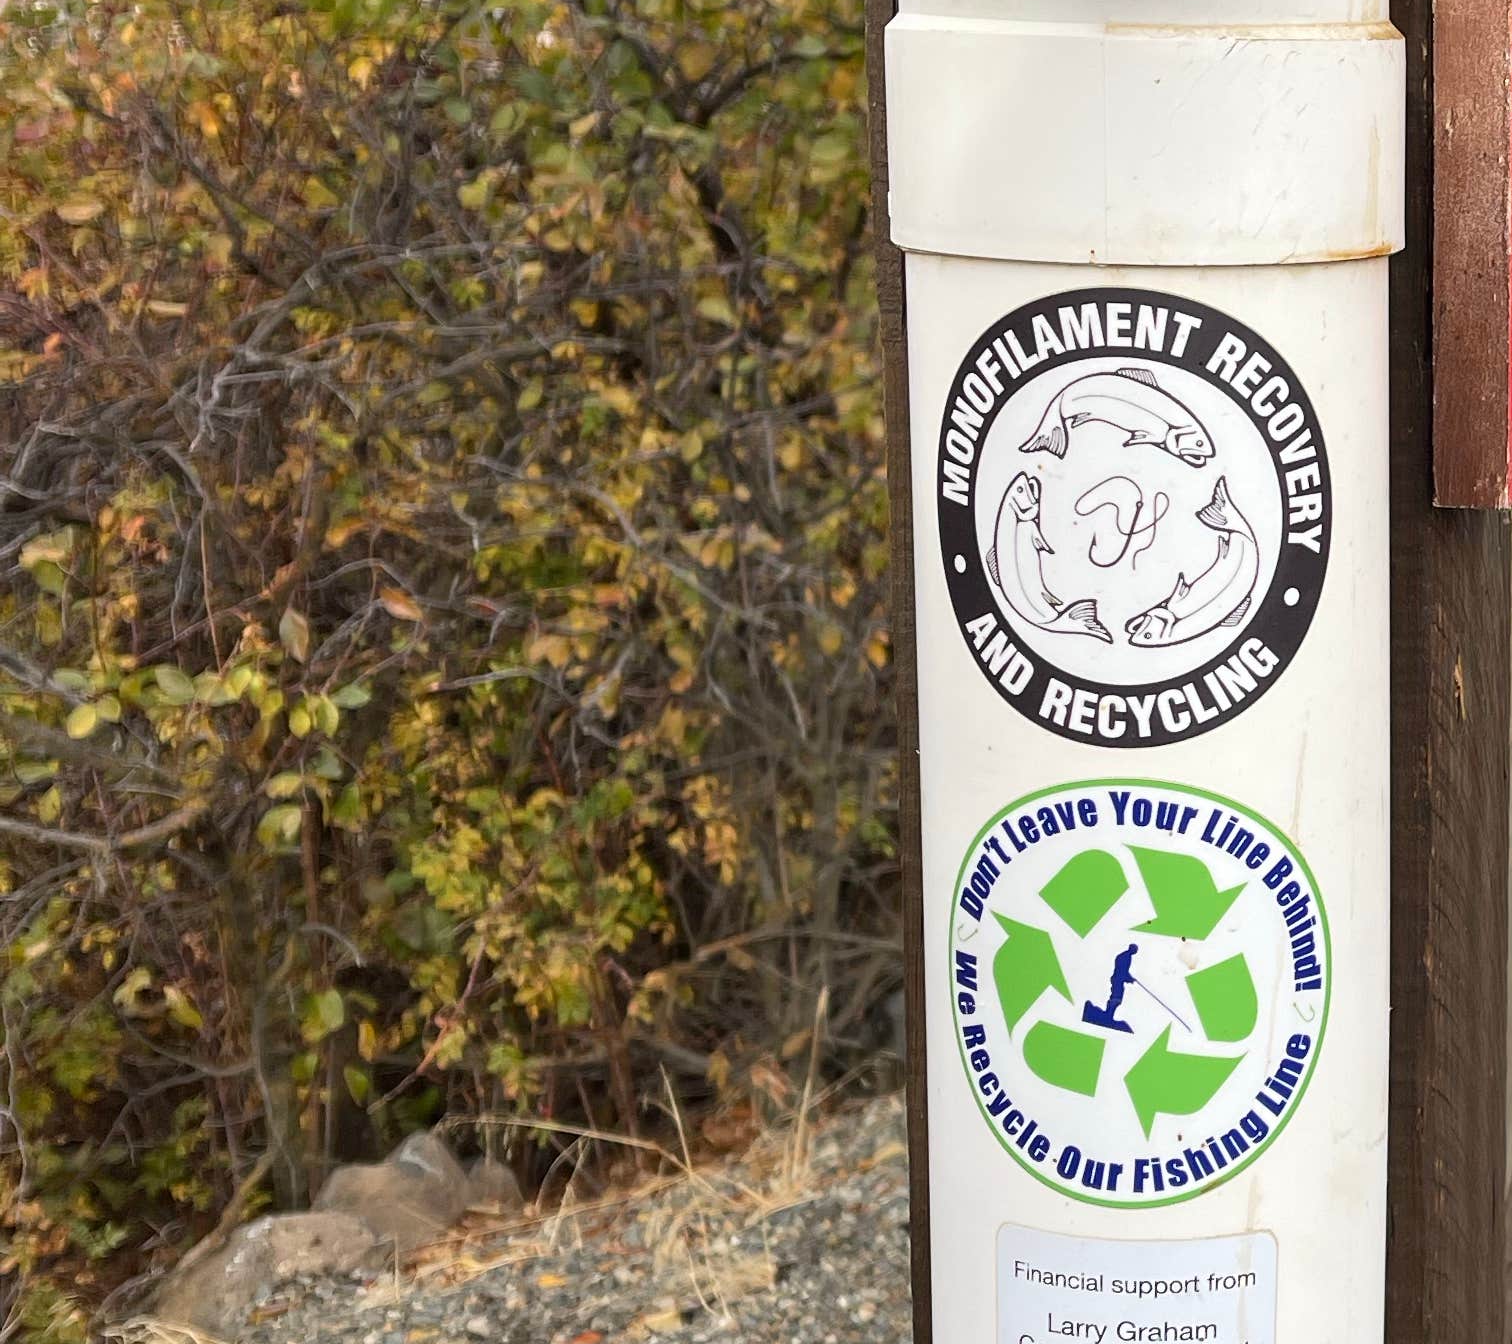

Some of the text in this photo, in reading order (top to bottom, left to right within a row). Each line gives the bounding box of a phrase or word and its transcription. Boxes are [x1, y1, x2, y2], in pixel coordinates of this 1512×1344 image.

[942, 302, 1324, 554] MONOFILAMENT RECOVERY
[965, 612, 1280, 739] AND RECYCLING
[959, 791, 1322, 992] Don't Leave Your Line Behind!
[955, 949, 1311, 1194] We Recycle Our Fishing Line
[1014, 1260, 1257, 1299] Financial support from
[1047, 1312, 1218, 1344] Larry Graham
